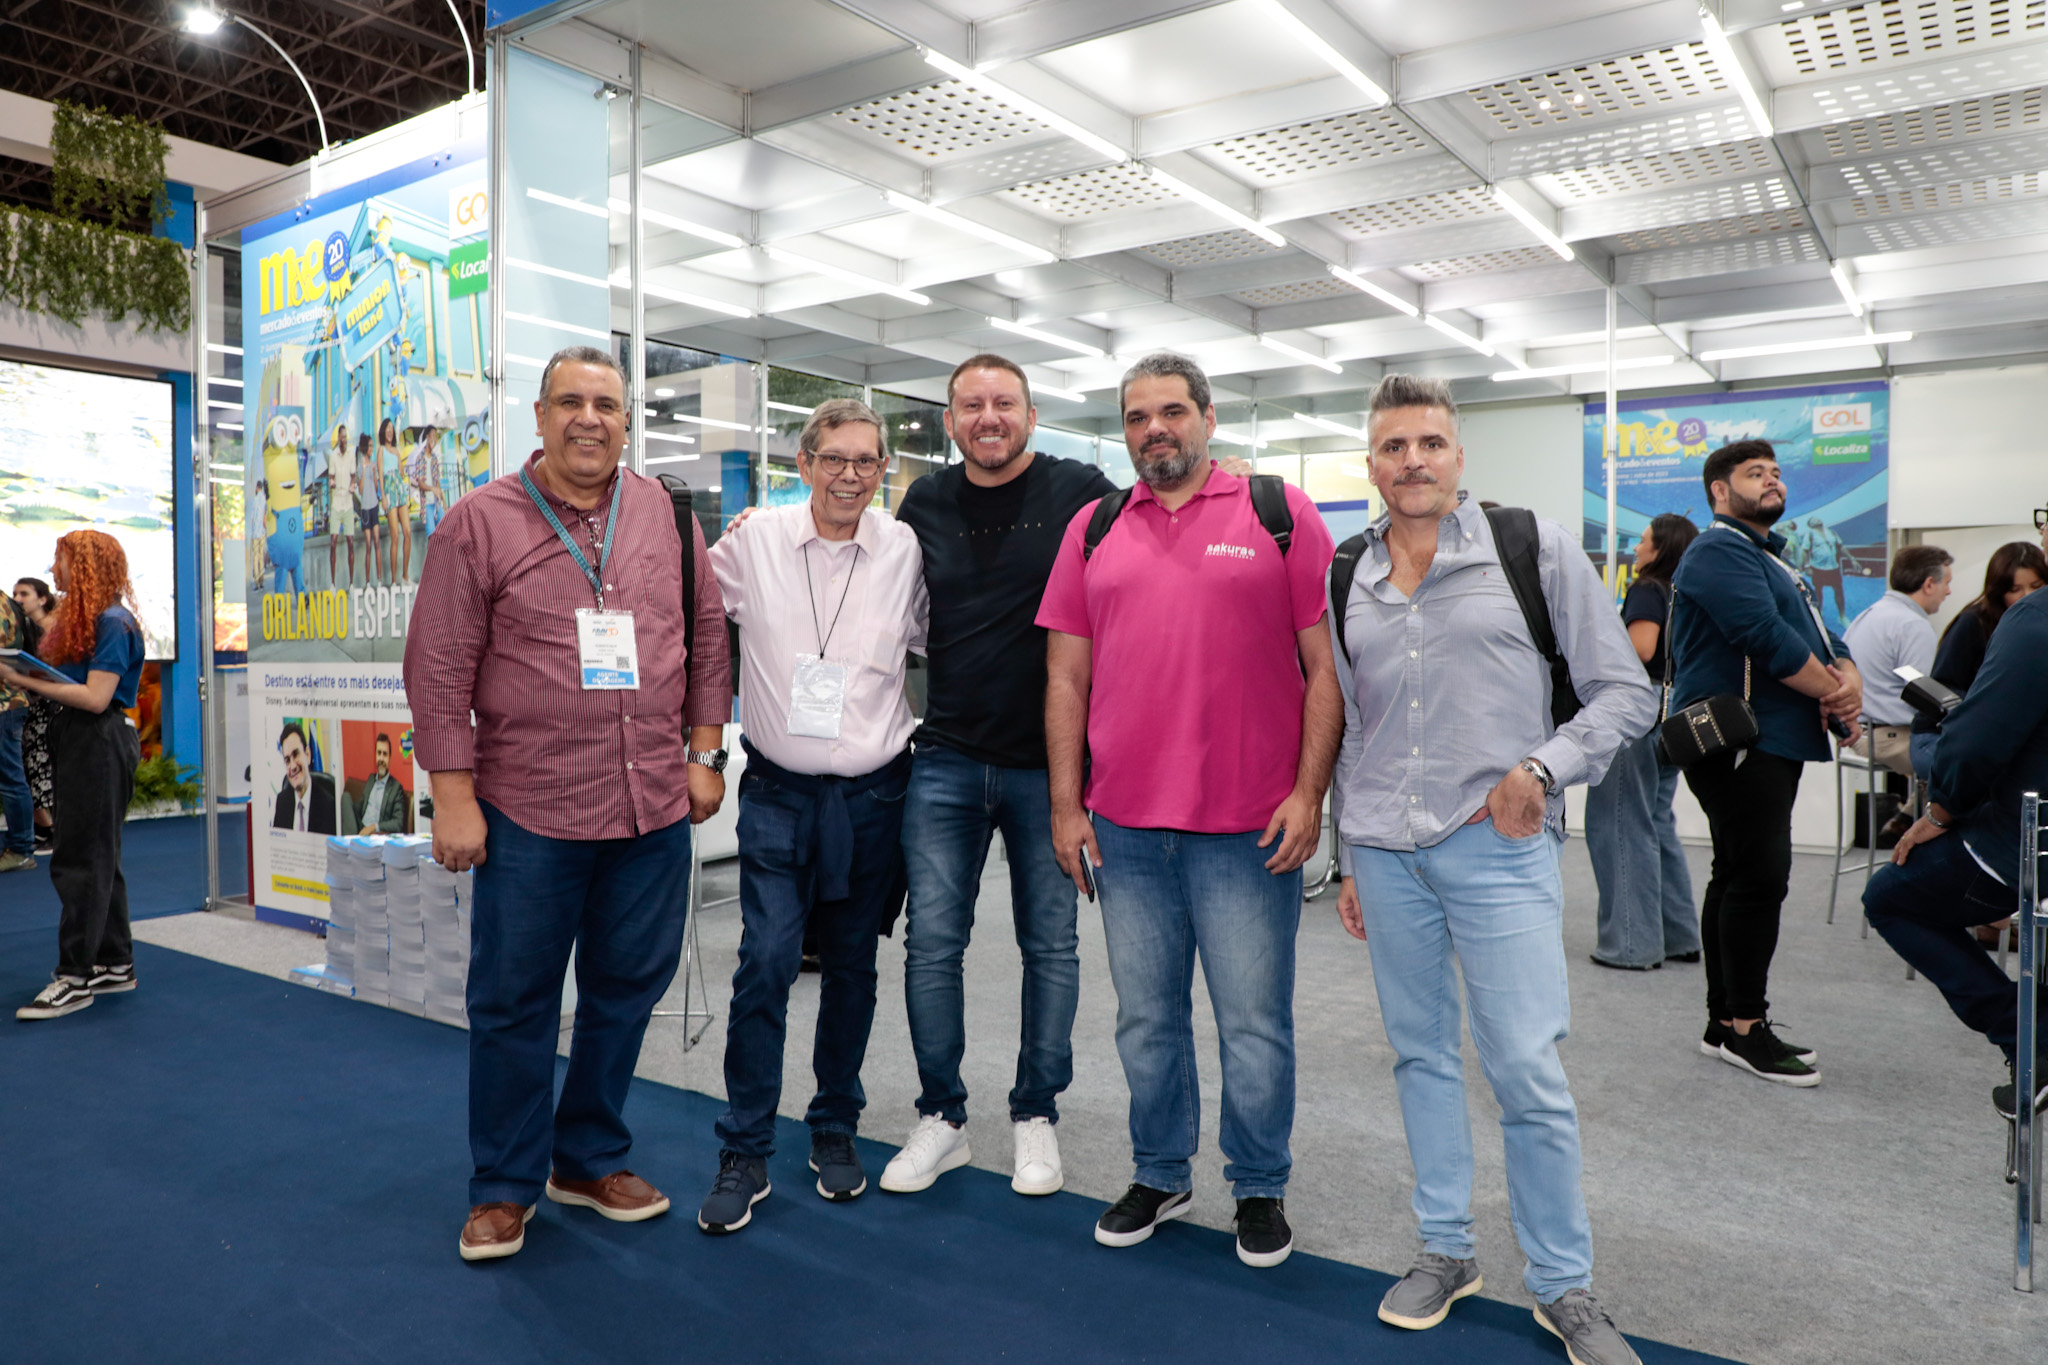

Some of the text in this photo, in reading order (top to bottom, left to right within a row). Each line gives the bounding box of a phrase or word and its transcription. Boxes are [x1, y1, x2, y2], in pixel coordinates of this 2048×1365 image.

[328, 238, 344, 266] 20
[358, 303, 384, 337] land
[1820, 409, 1864, 427] GOL
[1682, 422, 1700, 437] 20
[1823, 443, 1868, 456] Localiza
[1602, 457, 1681, 470] mrcado&eventos
[262, 584, 419, 641] ORLANDO ESPET
[265, 673, 294, 689] Destino
[296, 673, 313, 689] está
[314, 674, 336, 689] entre
[338, 677, 348, 689] os
[350, 674, 370, 689] mais
[381, 701, 394, 710] suas
